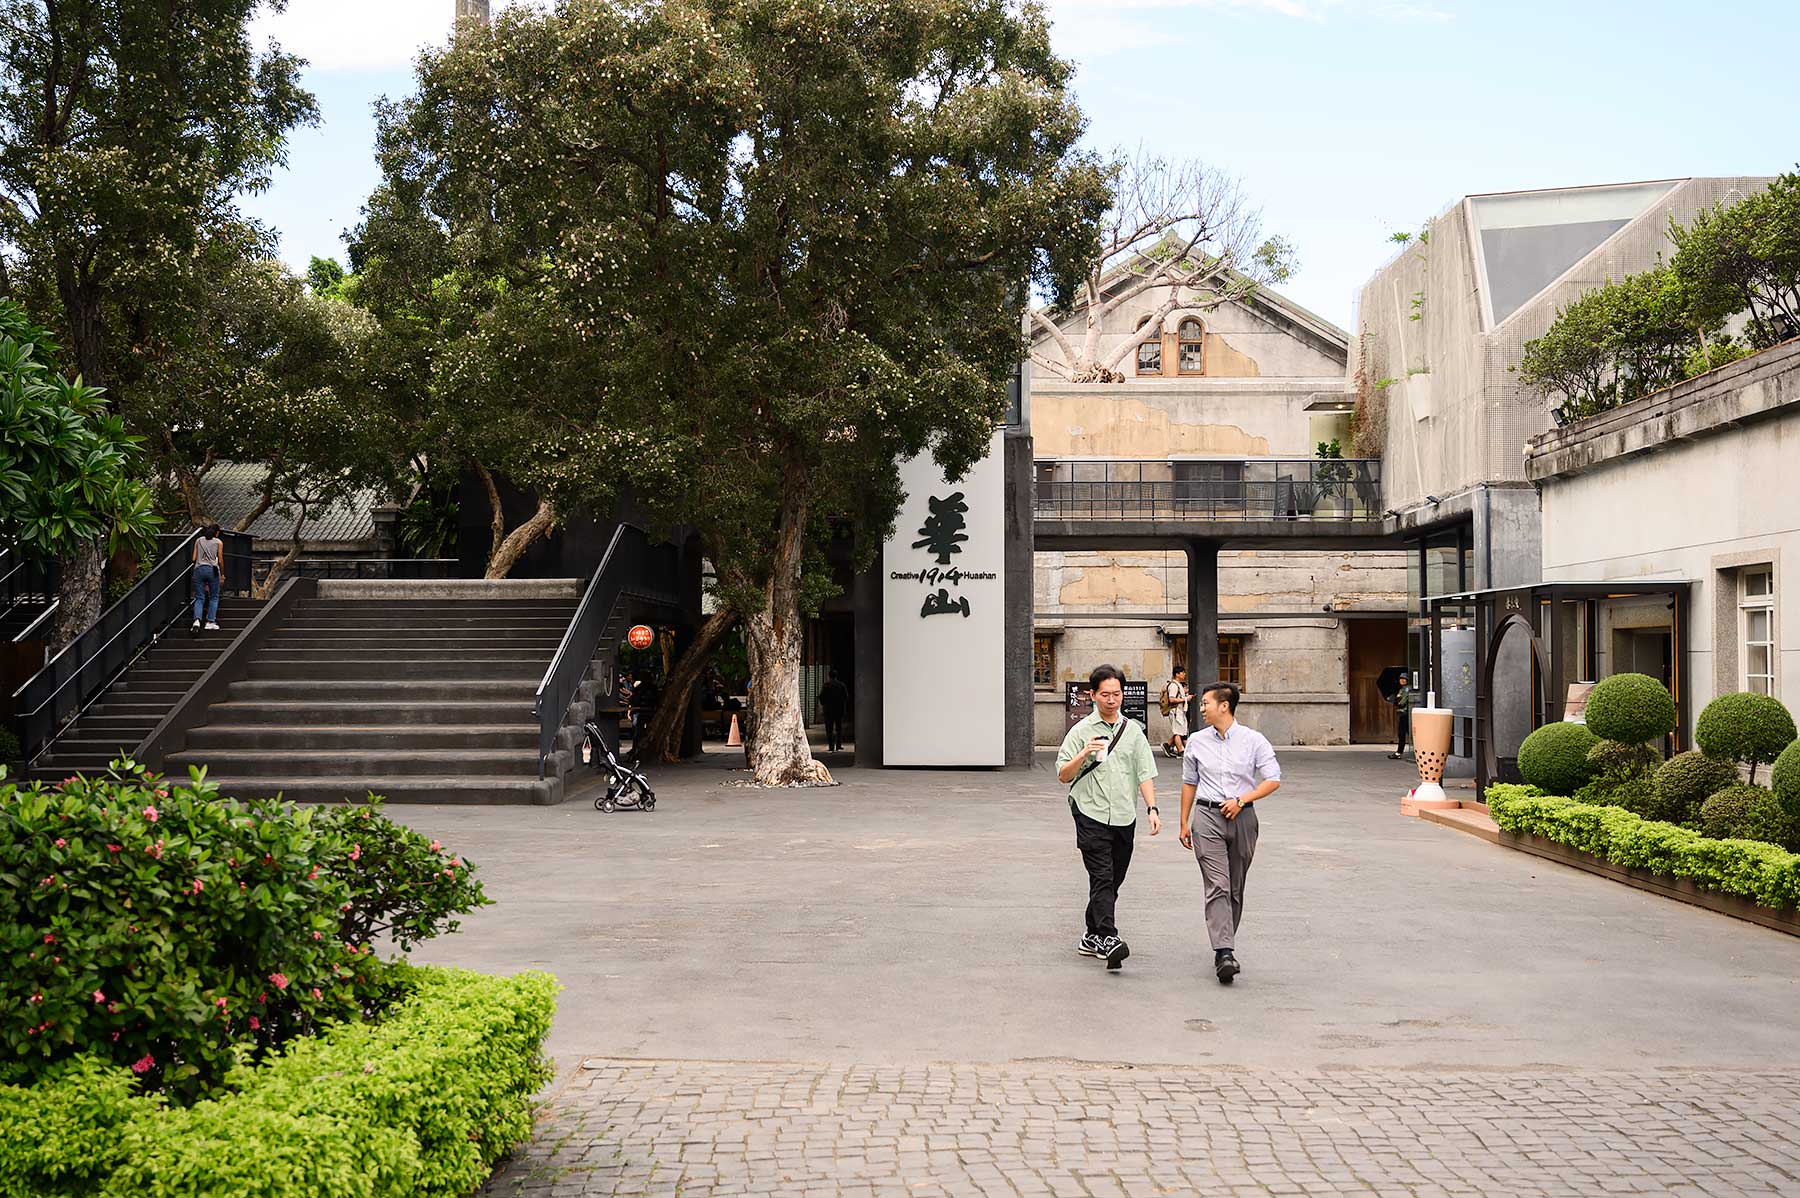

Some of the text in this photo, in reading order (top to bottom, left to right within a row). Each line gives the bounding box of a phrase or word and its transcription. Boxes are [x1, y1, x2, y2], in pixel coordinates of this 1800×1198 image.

[912, 492, 969, 564] 華
[890, 571, 919, 580] Creative
[963, 571, 997, 580] Huashan
[920, 588, 970, 618] 山
